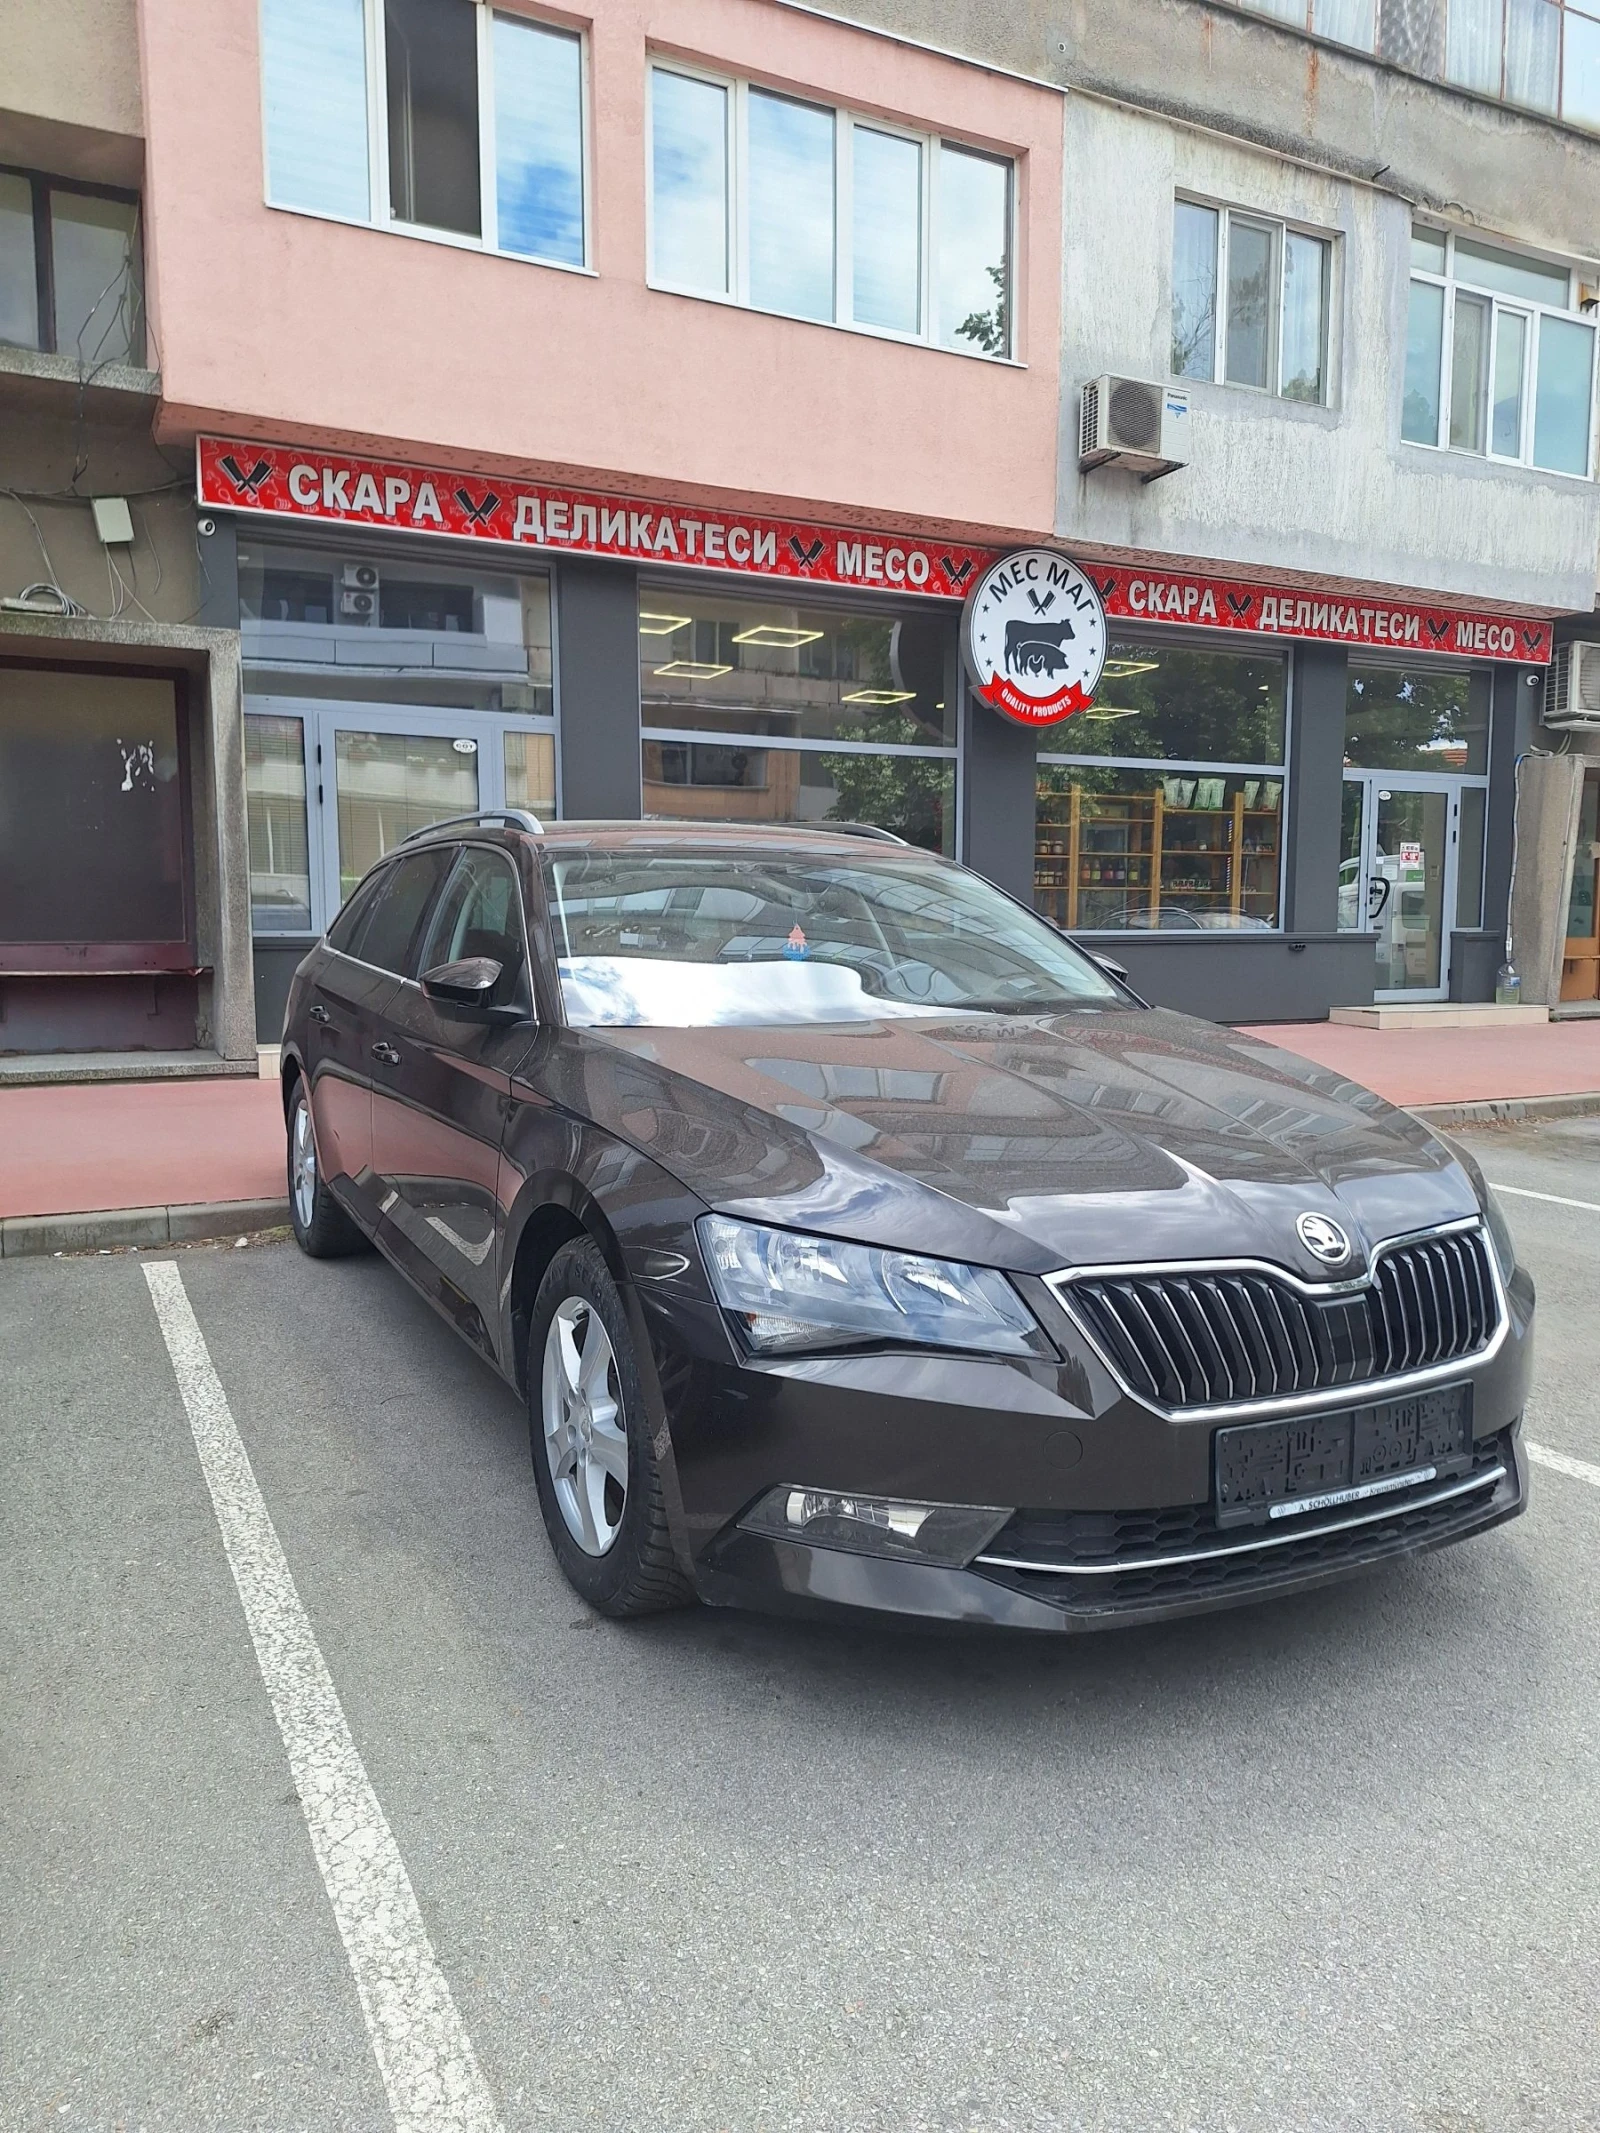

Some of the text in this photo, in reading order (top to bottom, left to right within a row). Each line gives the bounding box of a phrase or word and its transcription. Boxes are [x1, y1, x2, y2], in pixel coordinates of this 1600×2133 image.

[1167, 392, 1188, 401] Panasonic
[288, 463, 930, 585] СКАРА ДЕЛИКАТЕСИ МЕСО
[989, 558, 1095, 612] МЕС МАГ
[1128, 580, 1516, 653] СКАРА ДЕЛИКАТЕСИ МЕСО
[1001, 688, 1072, 718] QUALITY PRODUCTS
